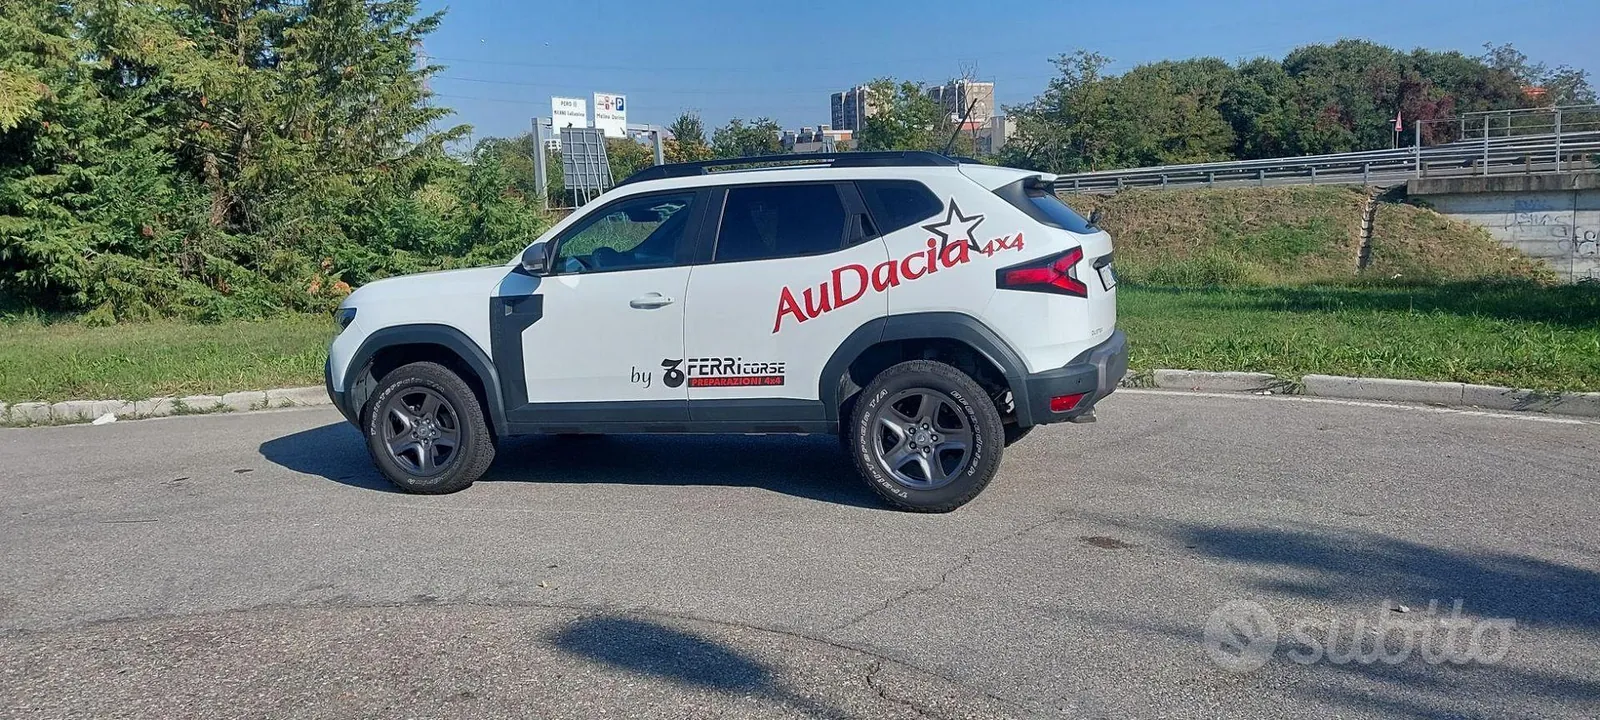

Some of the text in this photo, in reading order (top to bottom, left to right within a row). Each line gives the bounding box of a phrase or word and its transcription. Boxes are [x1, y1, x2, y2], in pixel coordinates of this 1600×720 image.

[772, 238, 971, 334] AuDacia
[631, 366, 652, 388] by
[691, 377, 762, 387] PREPARAZIONI
